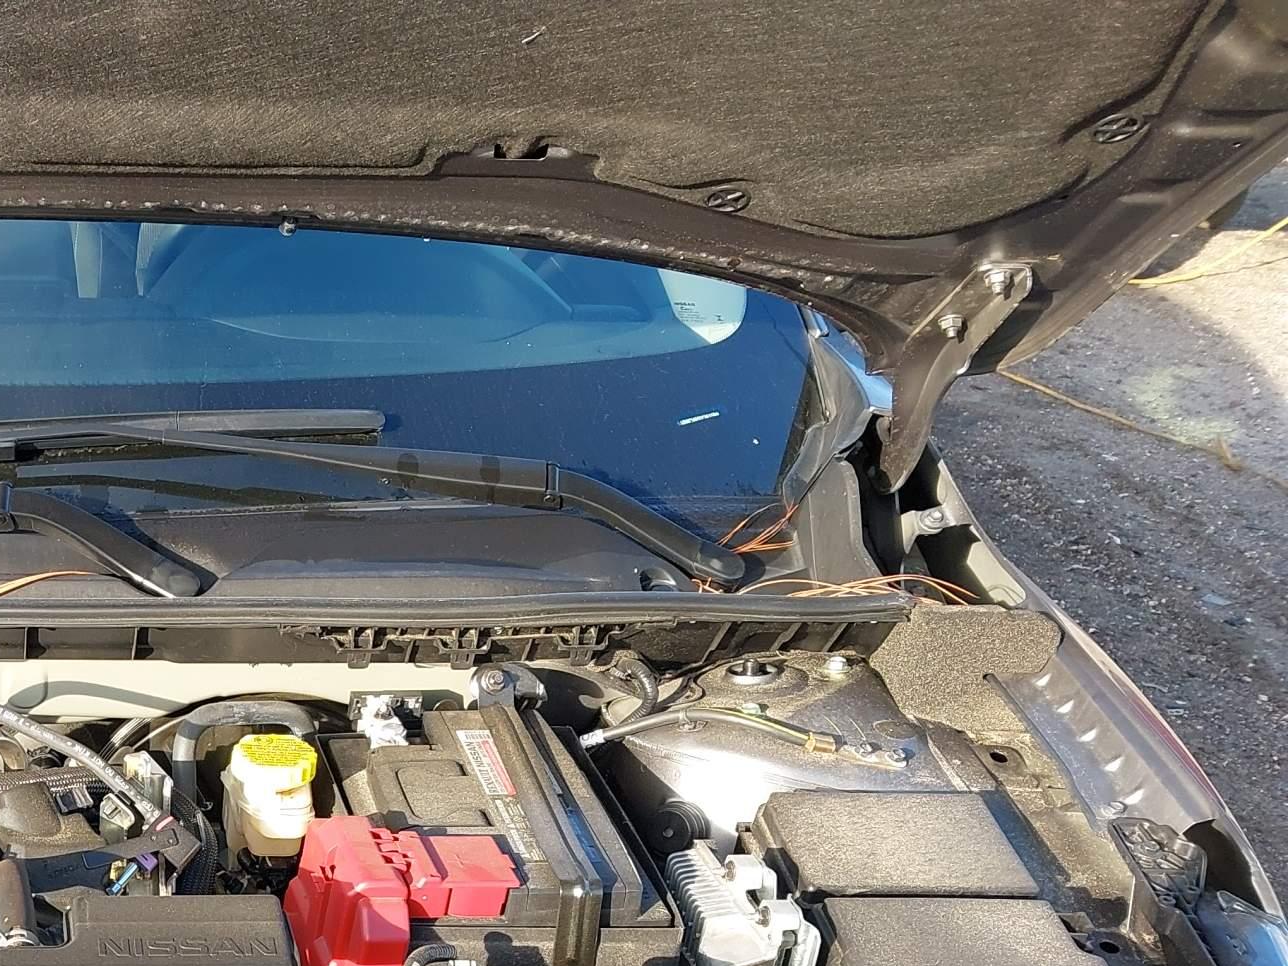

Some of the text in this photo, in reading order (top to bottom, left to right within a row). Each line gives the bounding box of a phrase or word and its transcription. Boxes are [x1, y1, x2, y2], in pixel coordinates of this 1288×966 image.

[91, 756, 105, 768] NOT
[464, 740, 487, 768] NISSAN
[97, 936, 279, 957] NISSAN
